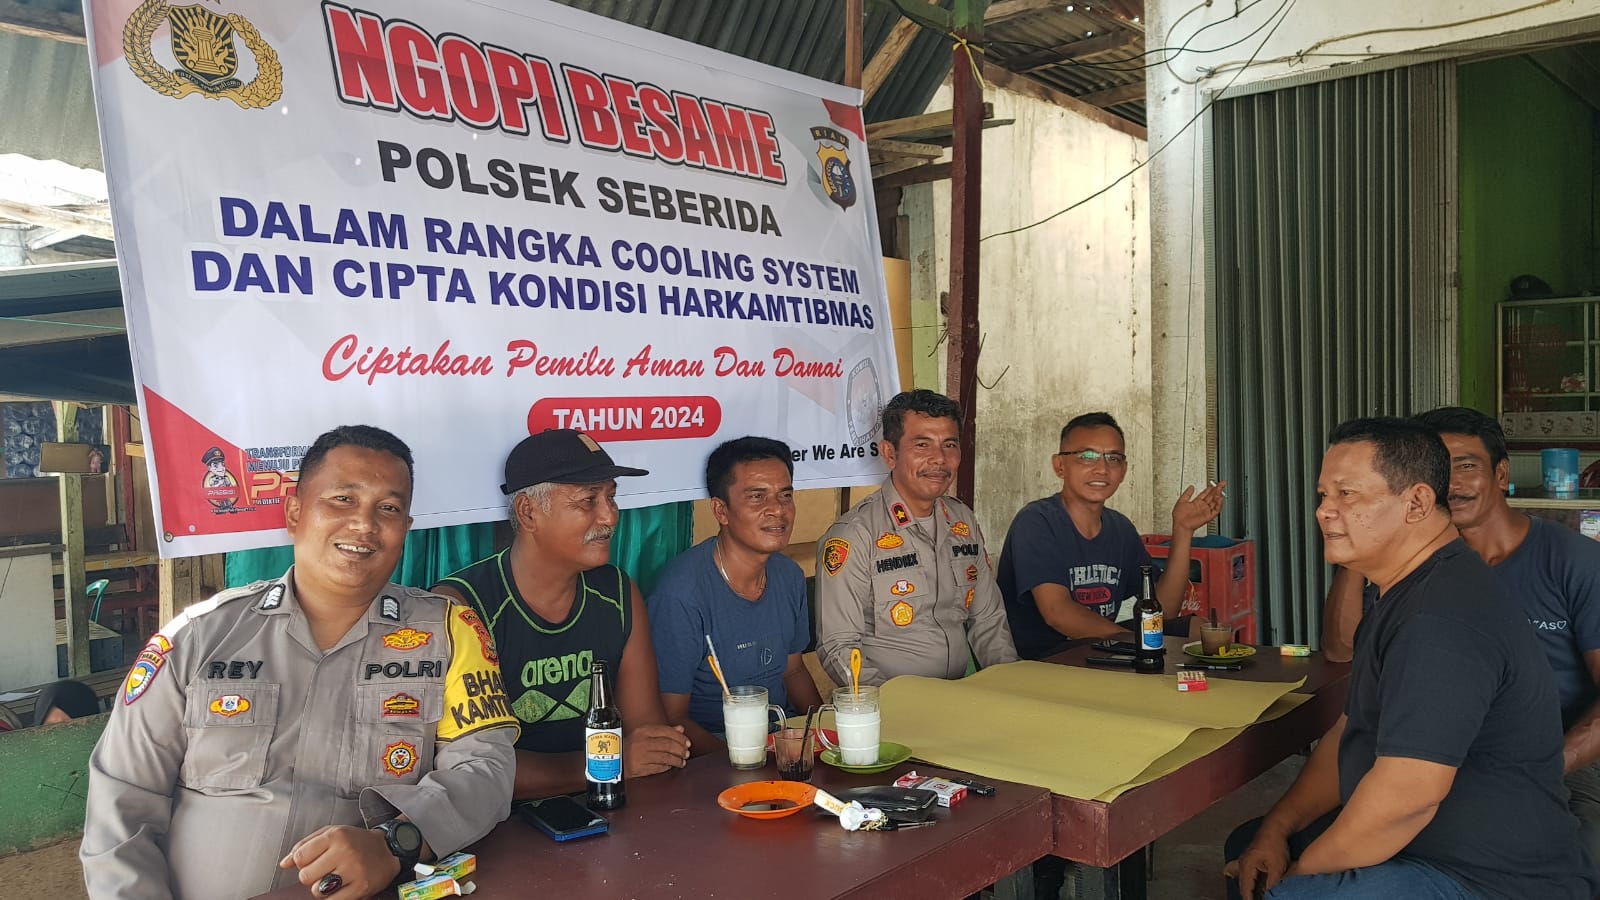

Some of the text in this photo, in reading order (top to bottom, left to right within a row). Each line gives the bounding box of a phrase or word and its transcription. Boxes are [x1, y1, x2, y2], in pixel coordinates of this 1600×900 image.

[322, 1, 787, 184] NGOPI BESAME
[815, 129, 846, 143] RIAU
[377, 140, 586, 208] POLSEK
[596, 176, 782, 236] SEBERIDA
[219, 197, 860, 294] DALAM RANGKA COOLING SYSTEM
[191, 251, 874, 330] DAN CIPTA KONDISI HARKAMTIBMAS
[322, 334, 843, 386] Ciptakan Pemilu Aman Dan Damai
[553, 406, 705, 431] TAHUN 2024
[245, 446, 310, 459] TRANSFORM
[812, 444, 835, 460] We
[840, 443, 865, 459] Are
[207, 660, 264, 680] REY
[364, 660, 442, 680] POLRI
[521, 650, 593, 688] arena
